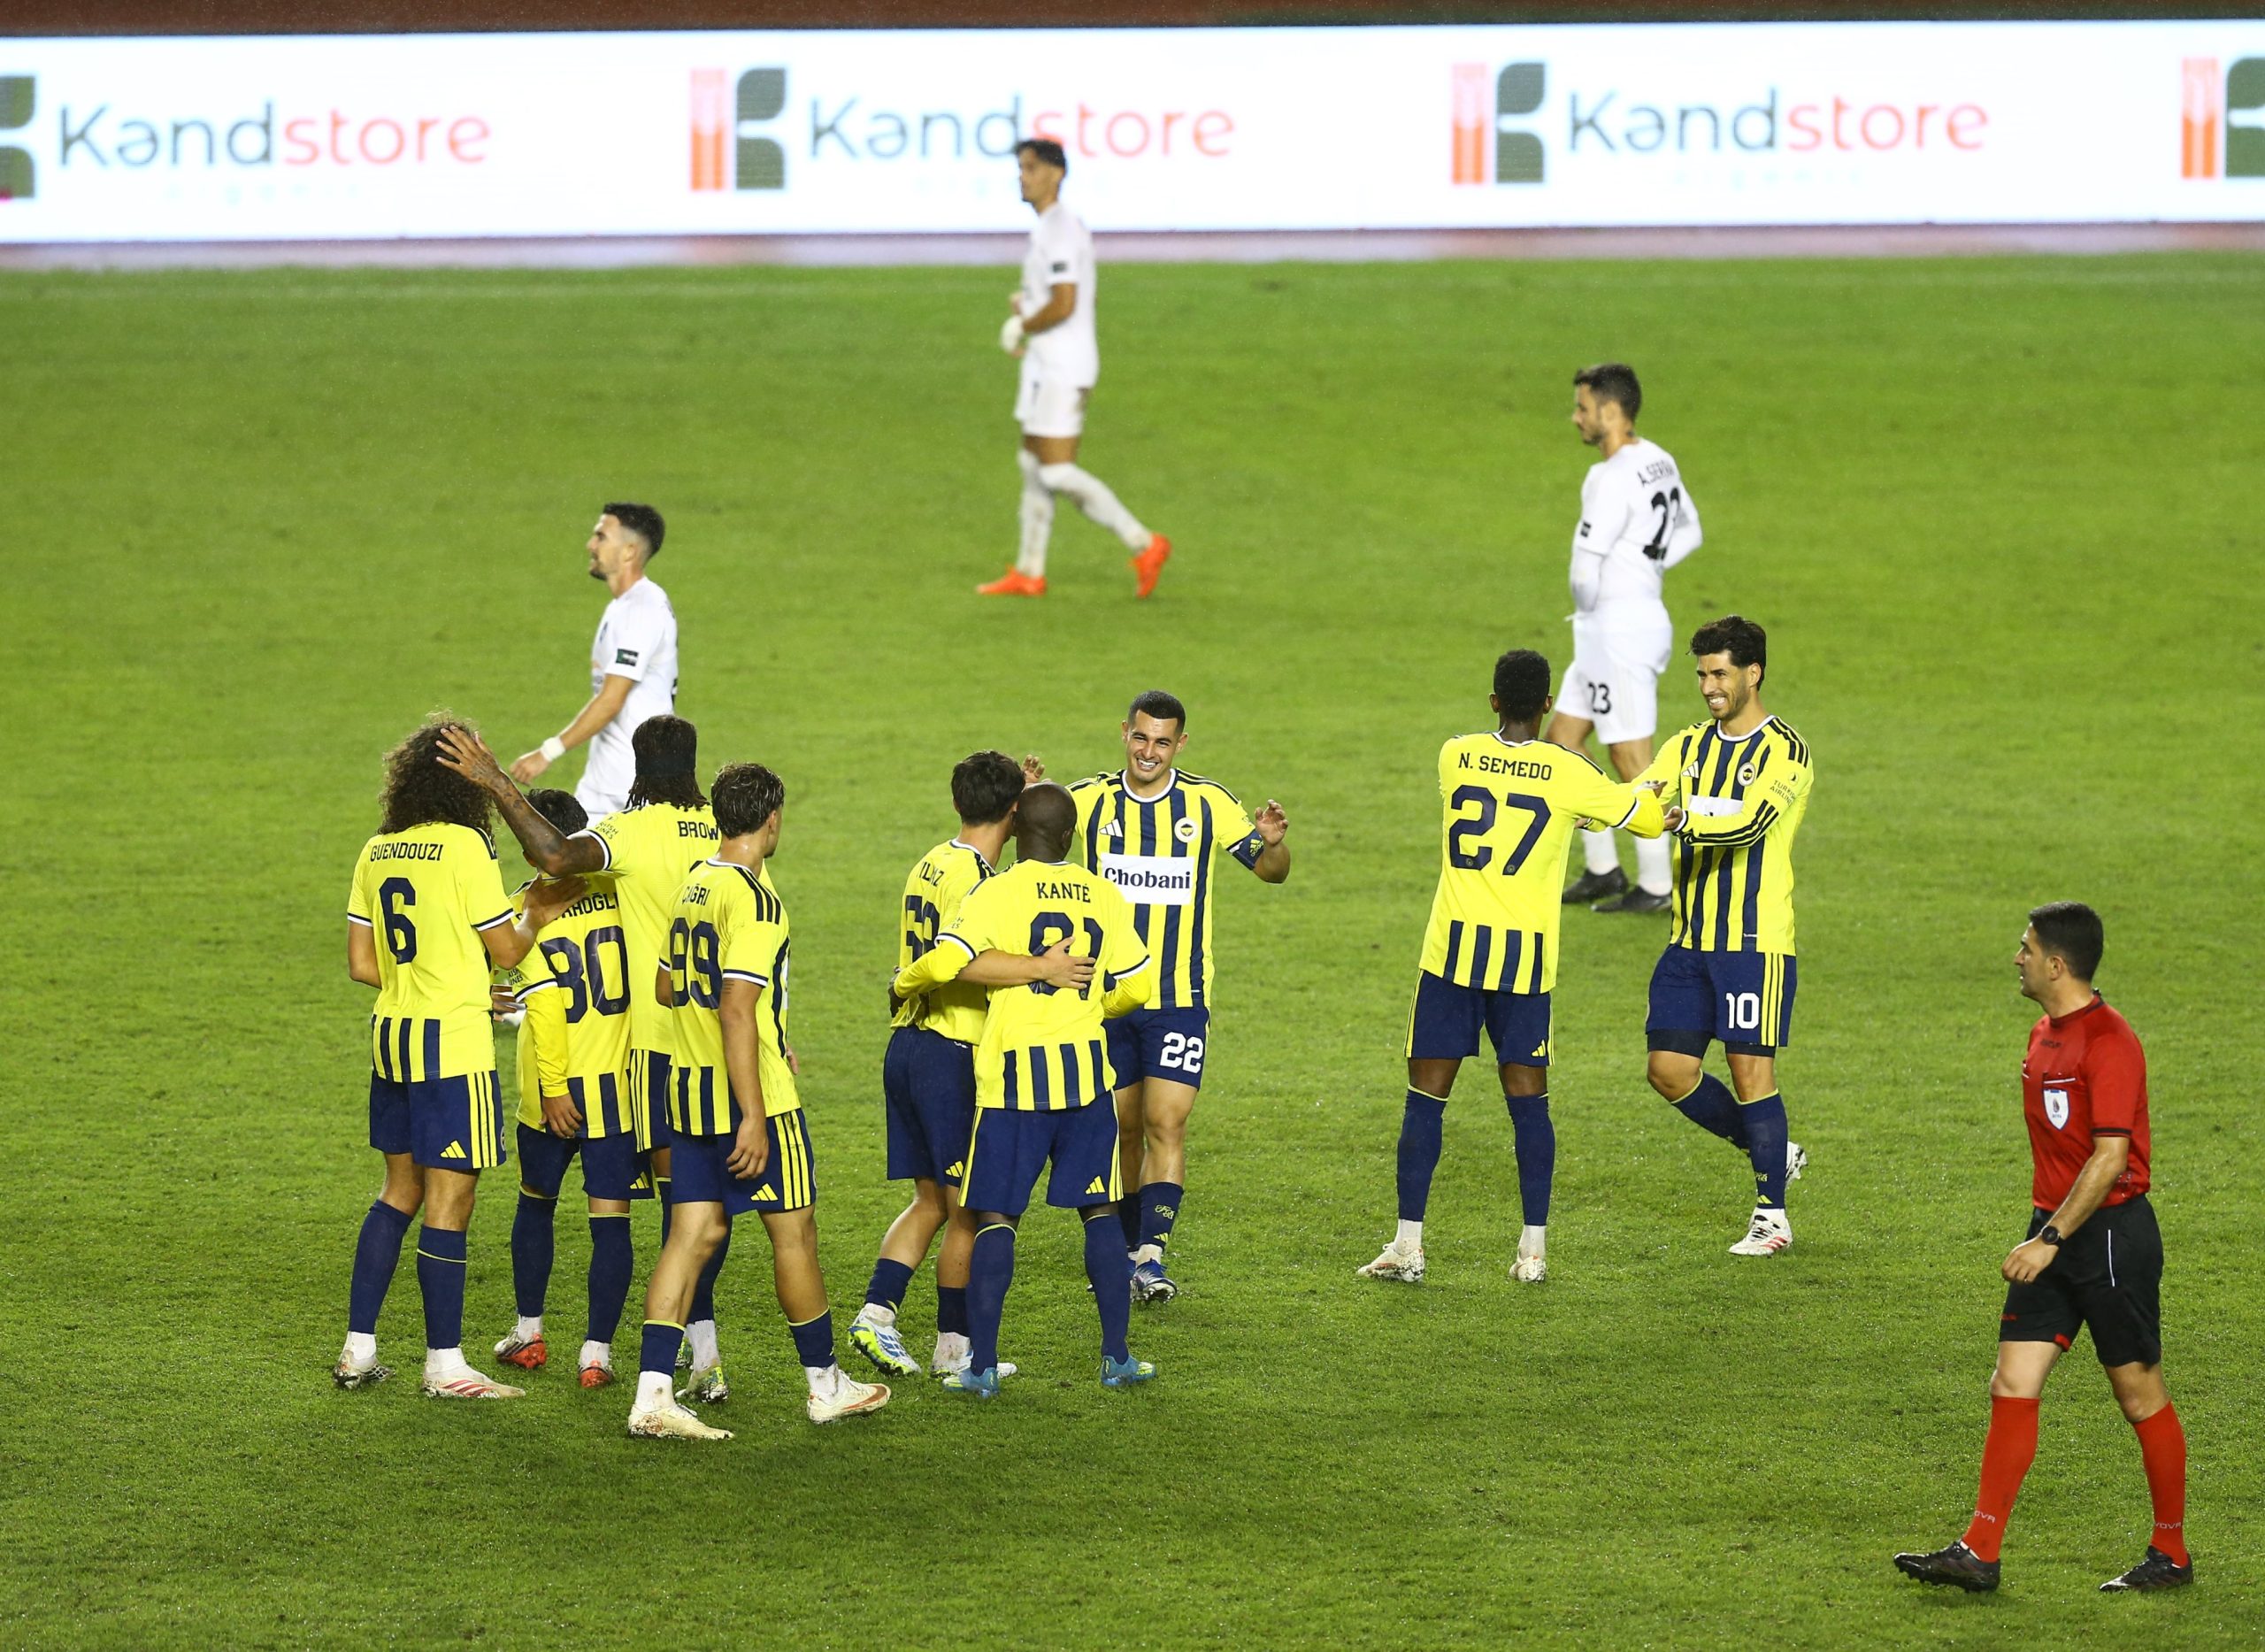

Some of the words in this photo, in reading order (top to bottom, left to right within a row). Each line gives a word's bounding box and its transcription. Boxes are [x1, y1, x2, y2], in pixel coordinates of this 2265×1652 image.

[58, 101, 493, 168] Kəndstore
[1569, 88, 1989, 153] Kəndstore
[1458, 752, 1473, 769] N.
[1478, 755, 1552, 780] SEMEDO
[677, 820, 719, 841] BROW
[1449, 784, 1552, 876] 27
[370, 842, 443, 862] GUENDOUZI
[1036, 881, 1091, 903] KANTÉ
[1104, 867, 1191, 889] Chobani
[379, 877, 418, 964] 6
[540, 925, 631, 1024] 80
[670, 917, 723, 1010] 99
[1725, 992, 1760, 1029] 10
[1160, 1031, 1204, 1074] 22
